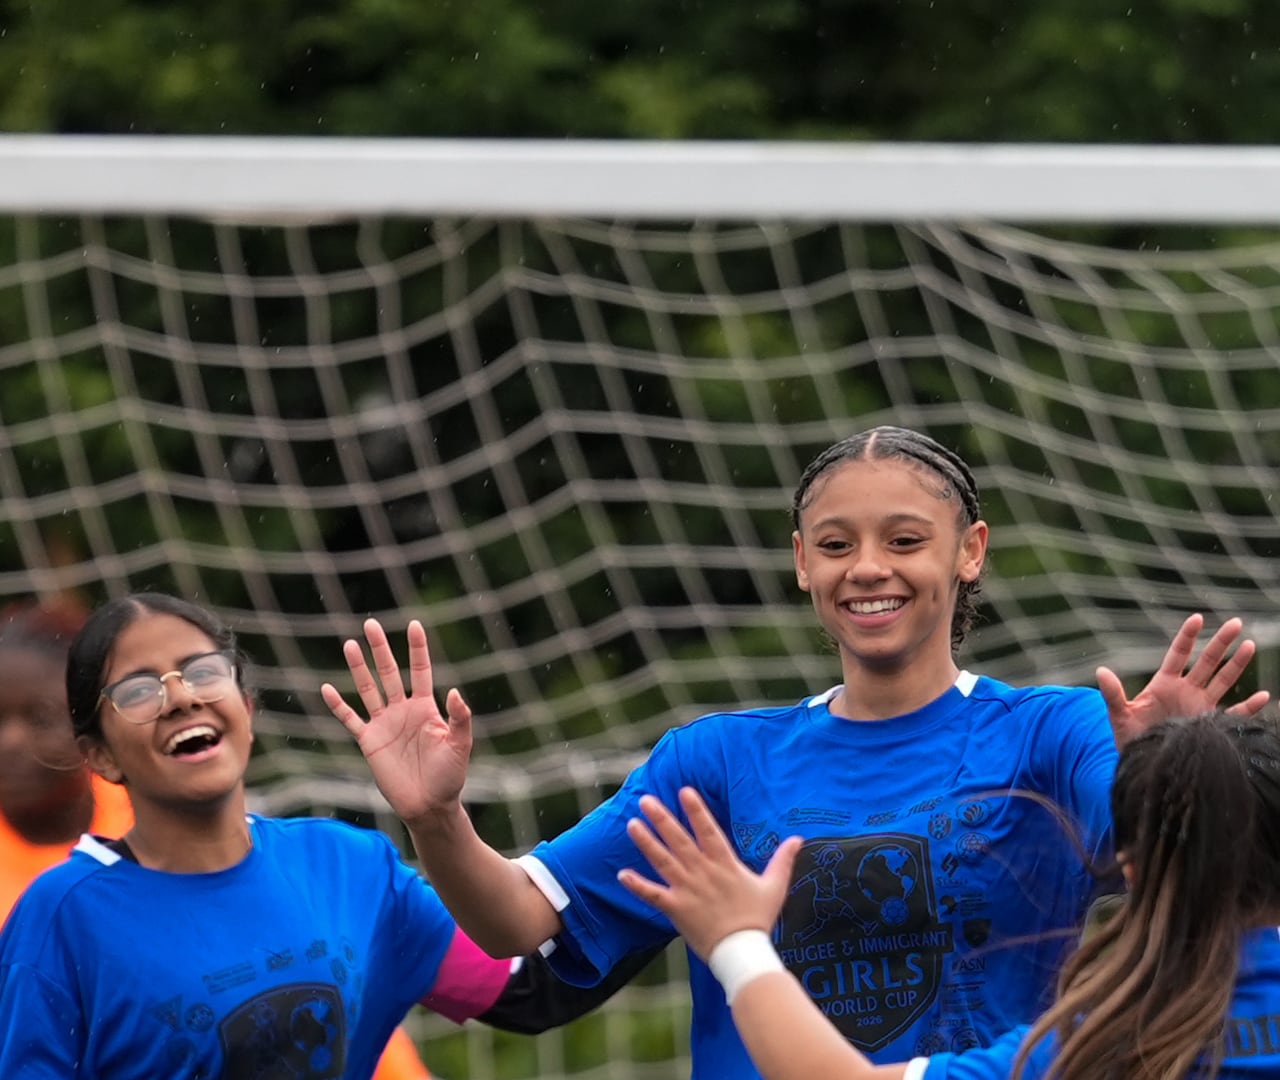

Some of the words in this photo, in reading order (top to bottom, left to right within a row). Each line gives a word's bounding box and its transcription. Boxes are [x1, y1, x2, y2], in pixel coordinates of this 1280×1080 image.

[781, 942, 837, 966] EFUGEE
[859, 931, 947, 953] IMMIGRANT
[801, 952, 925, 999] GIRLS
[821, 996, 877, 1017] WORLD
[885, 990, 918, 1009] CUP
